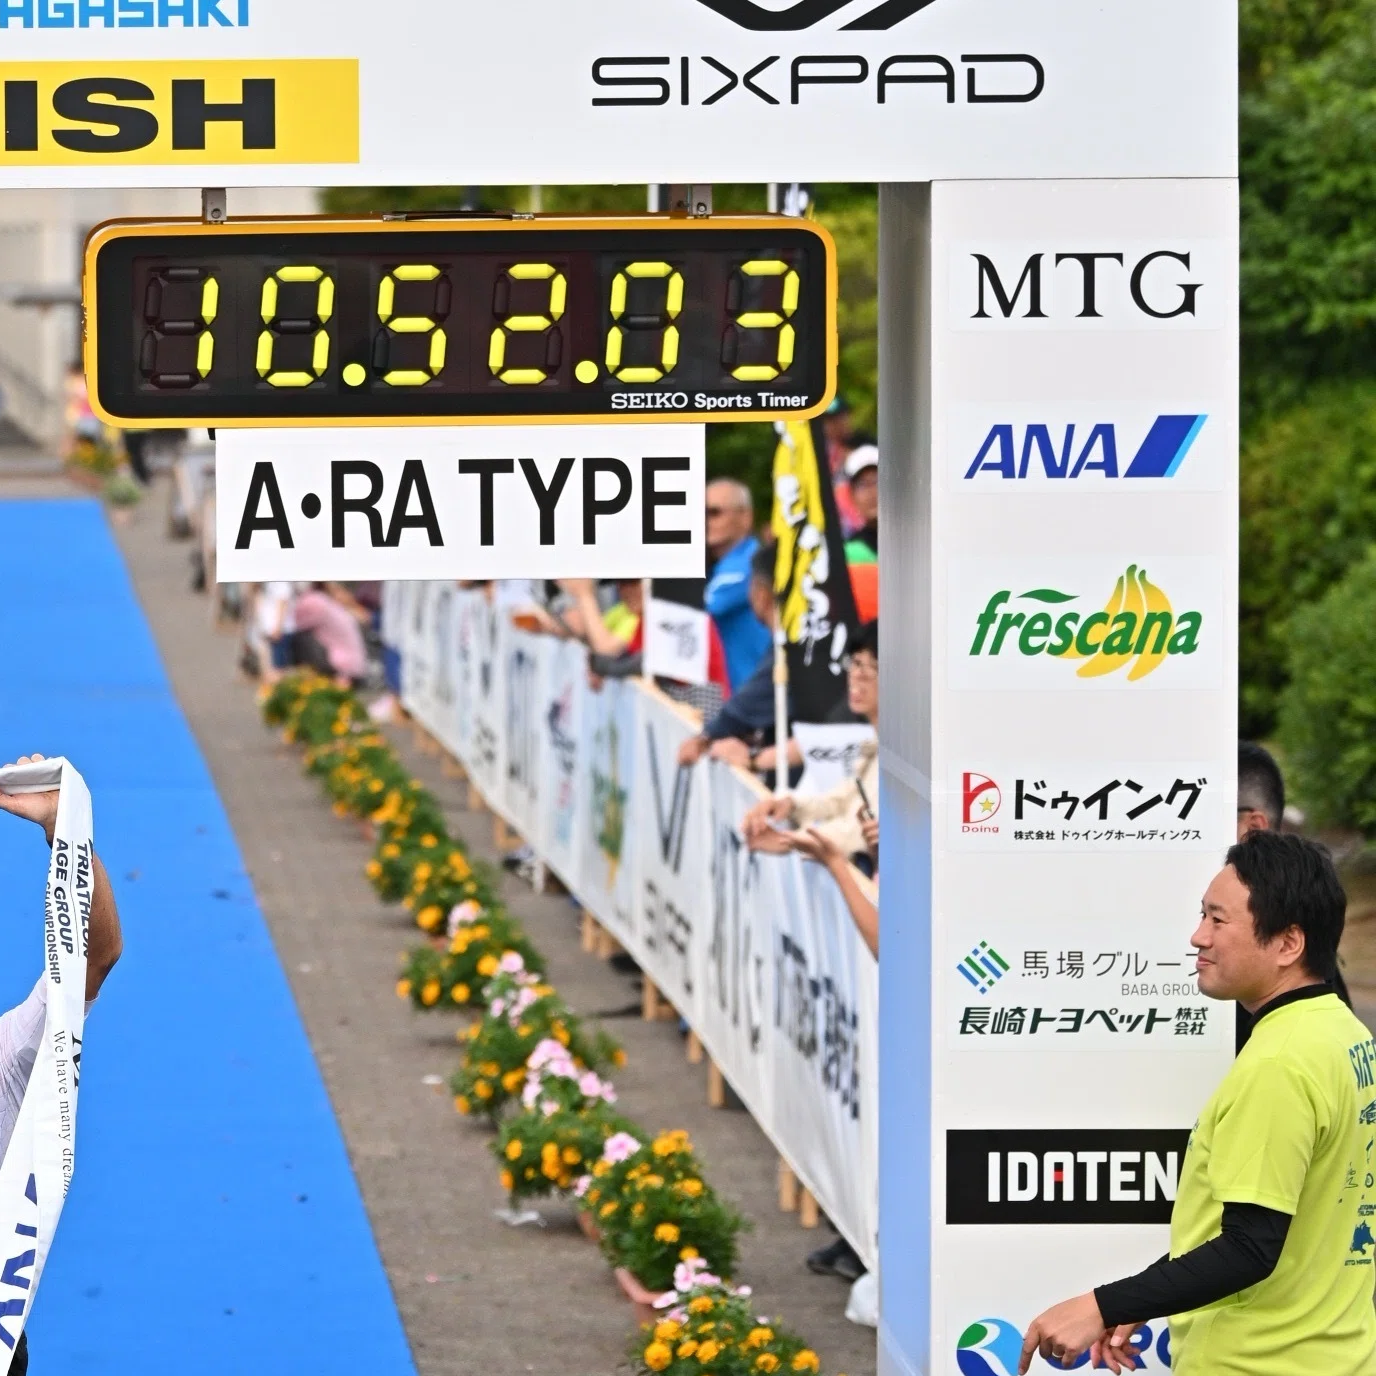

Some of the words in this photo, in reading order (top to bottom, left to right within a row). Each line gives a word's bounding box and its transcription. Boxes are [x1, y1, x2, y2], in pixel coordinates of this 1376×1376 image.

[591, 53, 1045, 107] SIXPAD
[969, 250, 1204, 319] MTG
[195, 259, 801, 387] 10.52.03
[610, 391, 689, 409] SEIKO
[694, 392, 753, 410] Sports
[757, 392, 809, 408] Timer
[963, 423, 1119, 480] ANA
[458, 456, 692, 547] TYPE
[968, 589, 1203, 657] frescana
[1014, 777, 1208, 821] ドゥイング
[961, 825, 1000, 834] Doing
[1013, 829, 1056, 841] 株式会社
[1061, 828, 1202, 841] ドゥイングホールディングス
[55, 838, 69, 882] AGE
[54, 886, 74, 955] GROUP
[75, 842, 90, 959] TRIATHLO
[1121, 983, 1159, 996] BABA
[1162, 983, 1200, 996] GROU
[54, 1030, 66, 1053] We
[958, 1006, 1173, 1036] 長崎トヨペット
[56, 1059, 68, 1094] have
[1348, 1038, 1376, 1092] STAF
[58, 1100, 72, 1142] many
[987, 1151, 1177, 1202] IDATEN
